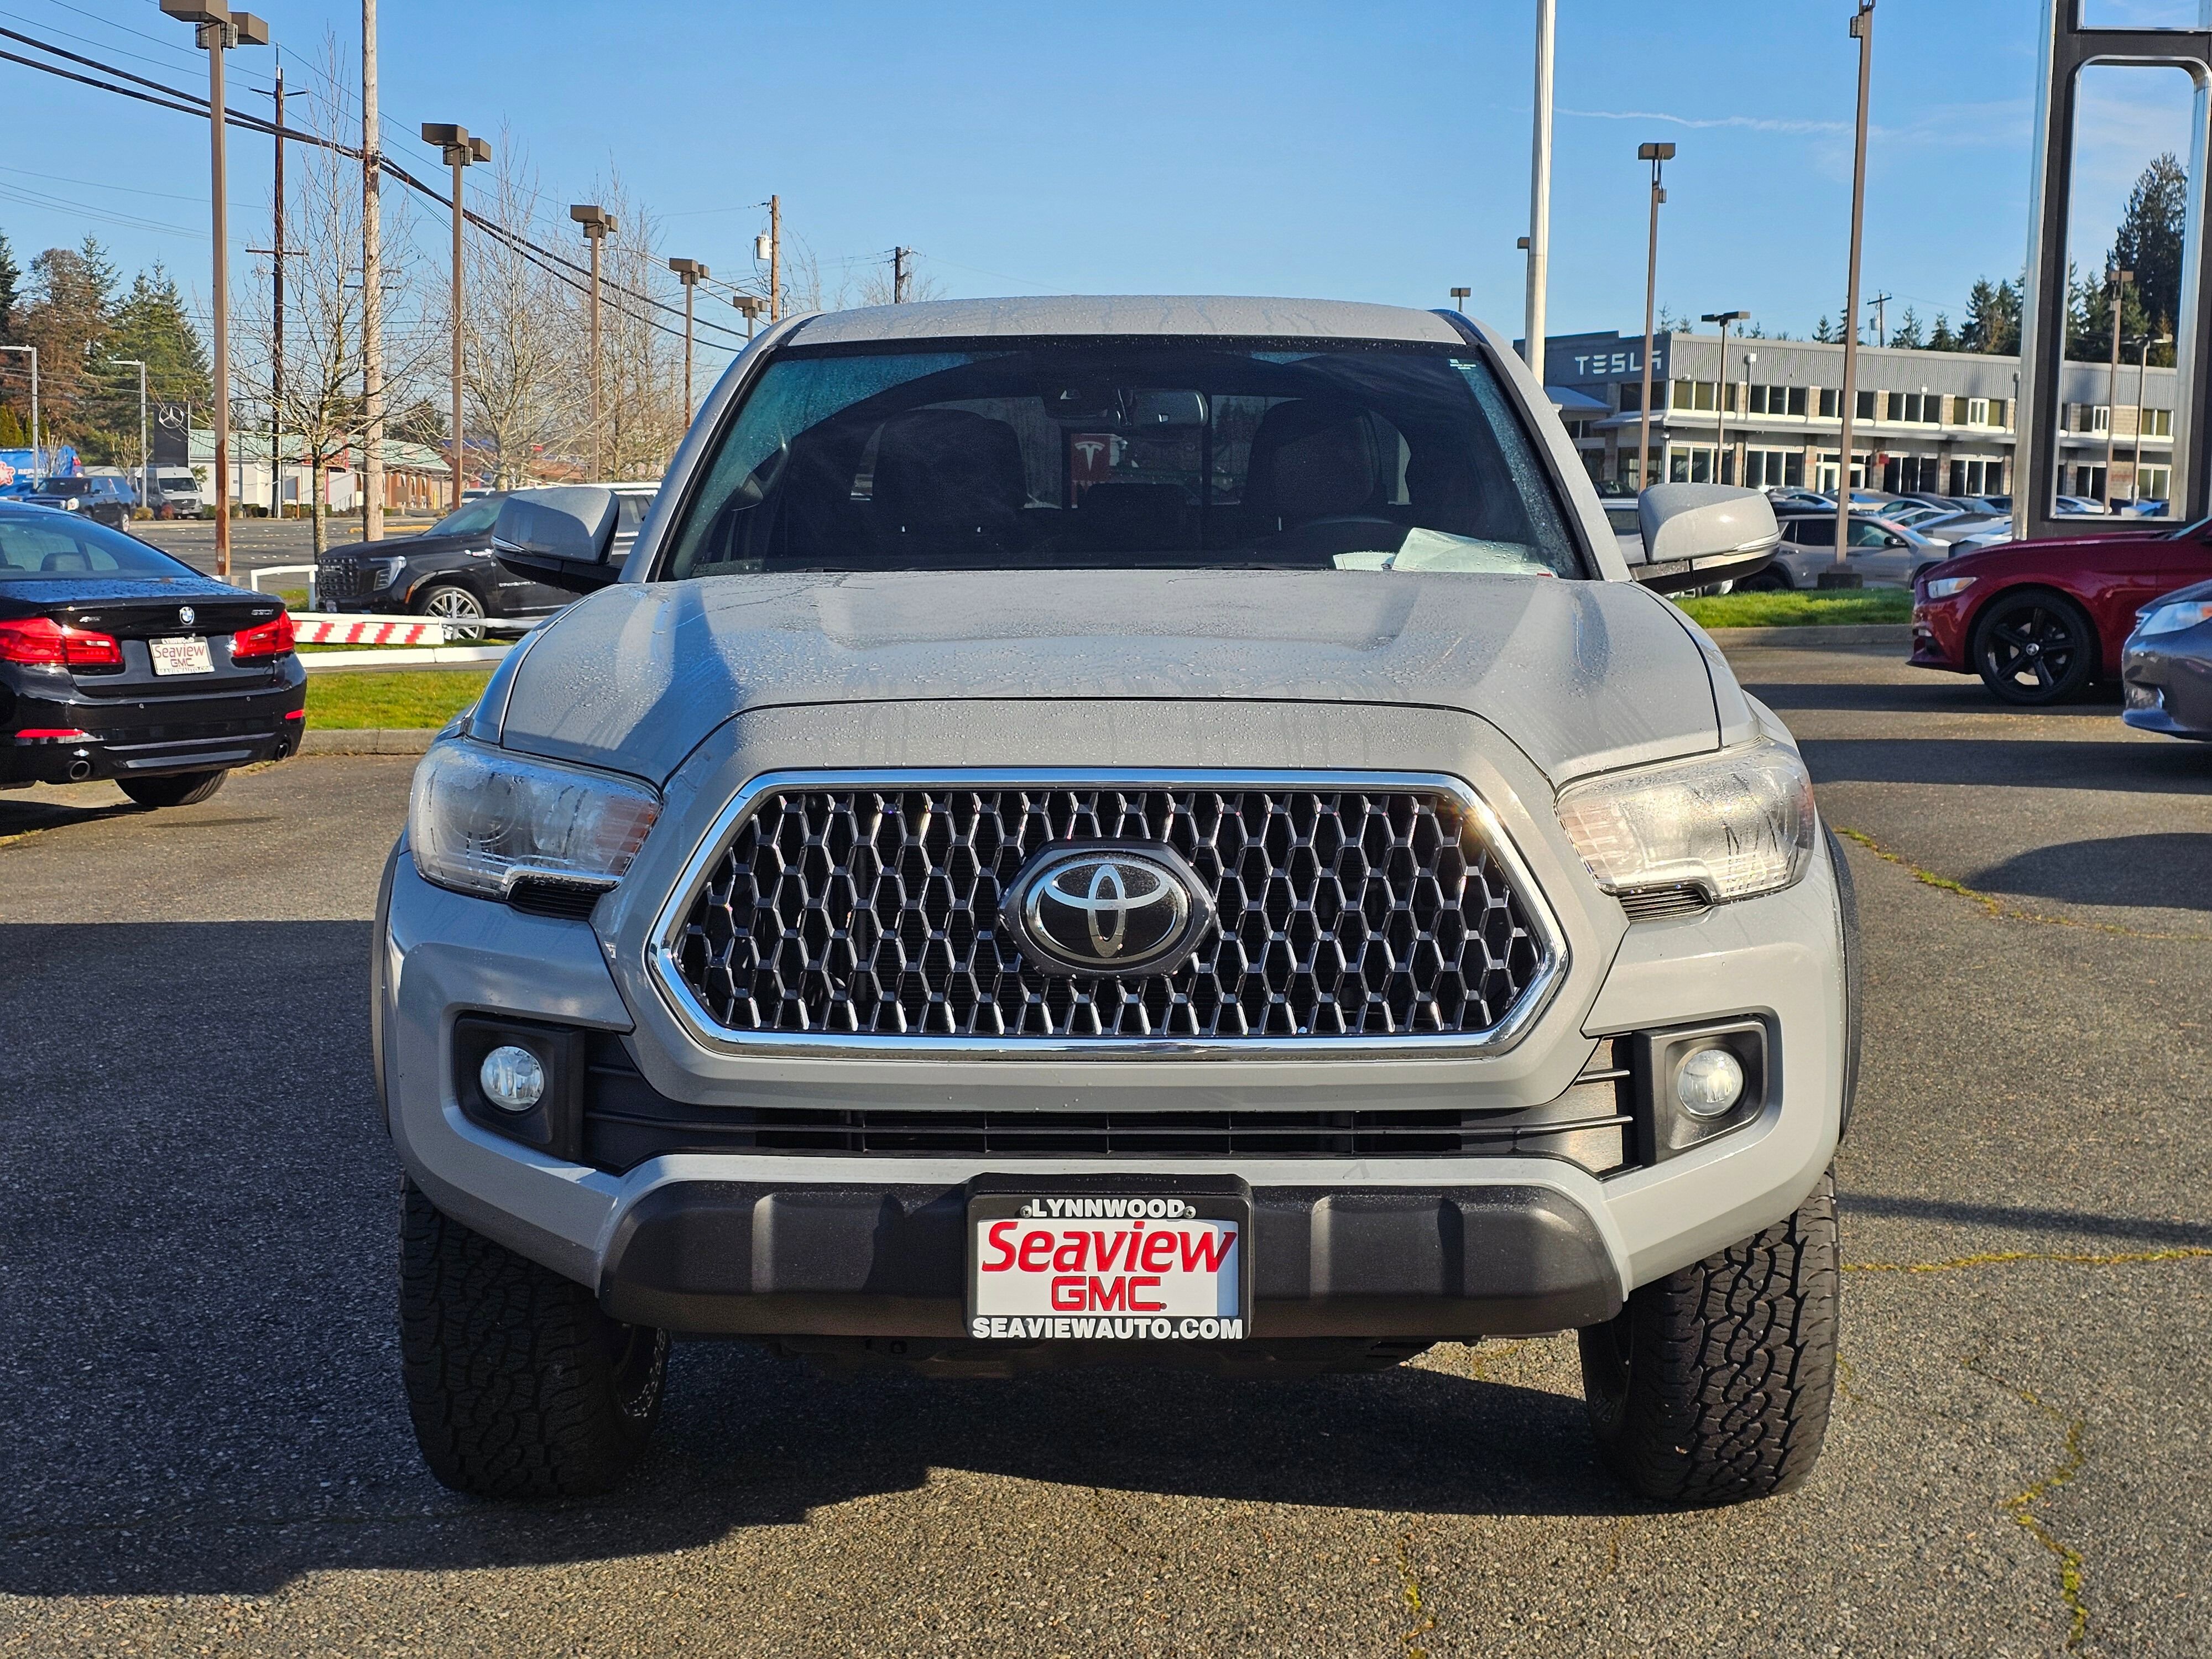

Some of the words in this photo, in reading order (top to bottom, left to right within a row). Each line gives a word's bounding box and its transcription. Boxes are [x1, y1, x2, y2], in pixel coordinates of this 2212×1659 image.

[1574, 350, 1662, 375] TESLA
[155, 644, 205, 658] Seaview
[170, 658, 195, 667] GMC
[1032, 1199, 1185, 1218] LYNNWOOD
[982, 1221, 1237, 1272] Seaview
[1051, 1276, 1161, 1312] GMC
[972, 1317, 1243, 1339] SEAVIEWAUTO.COM
